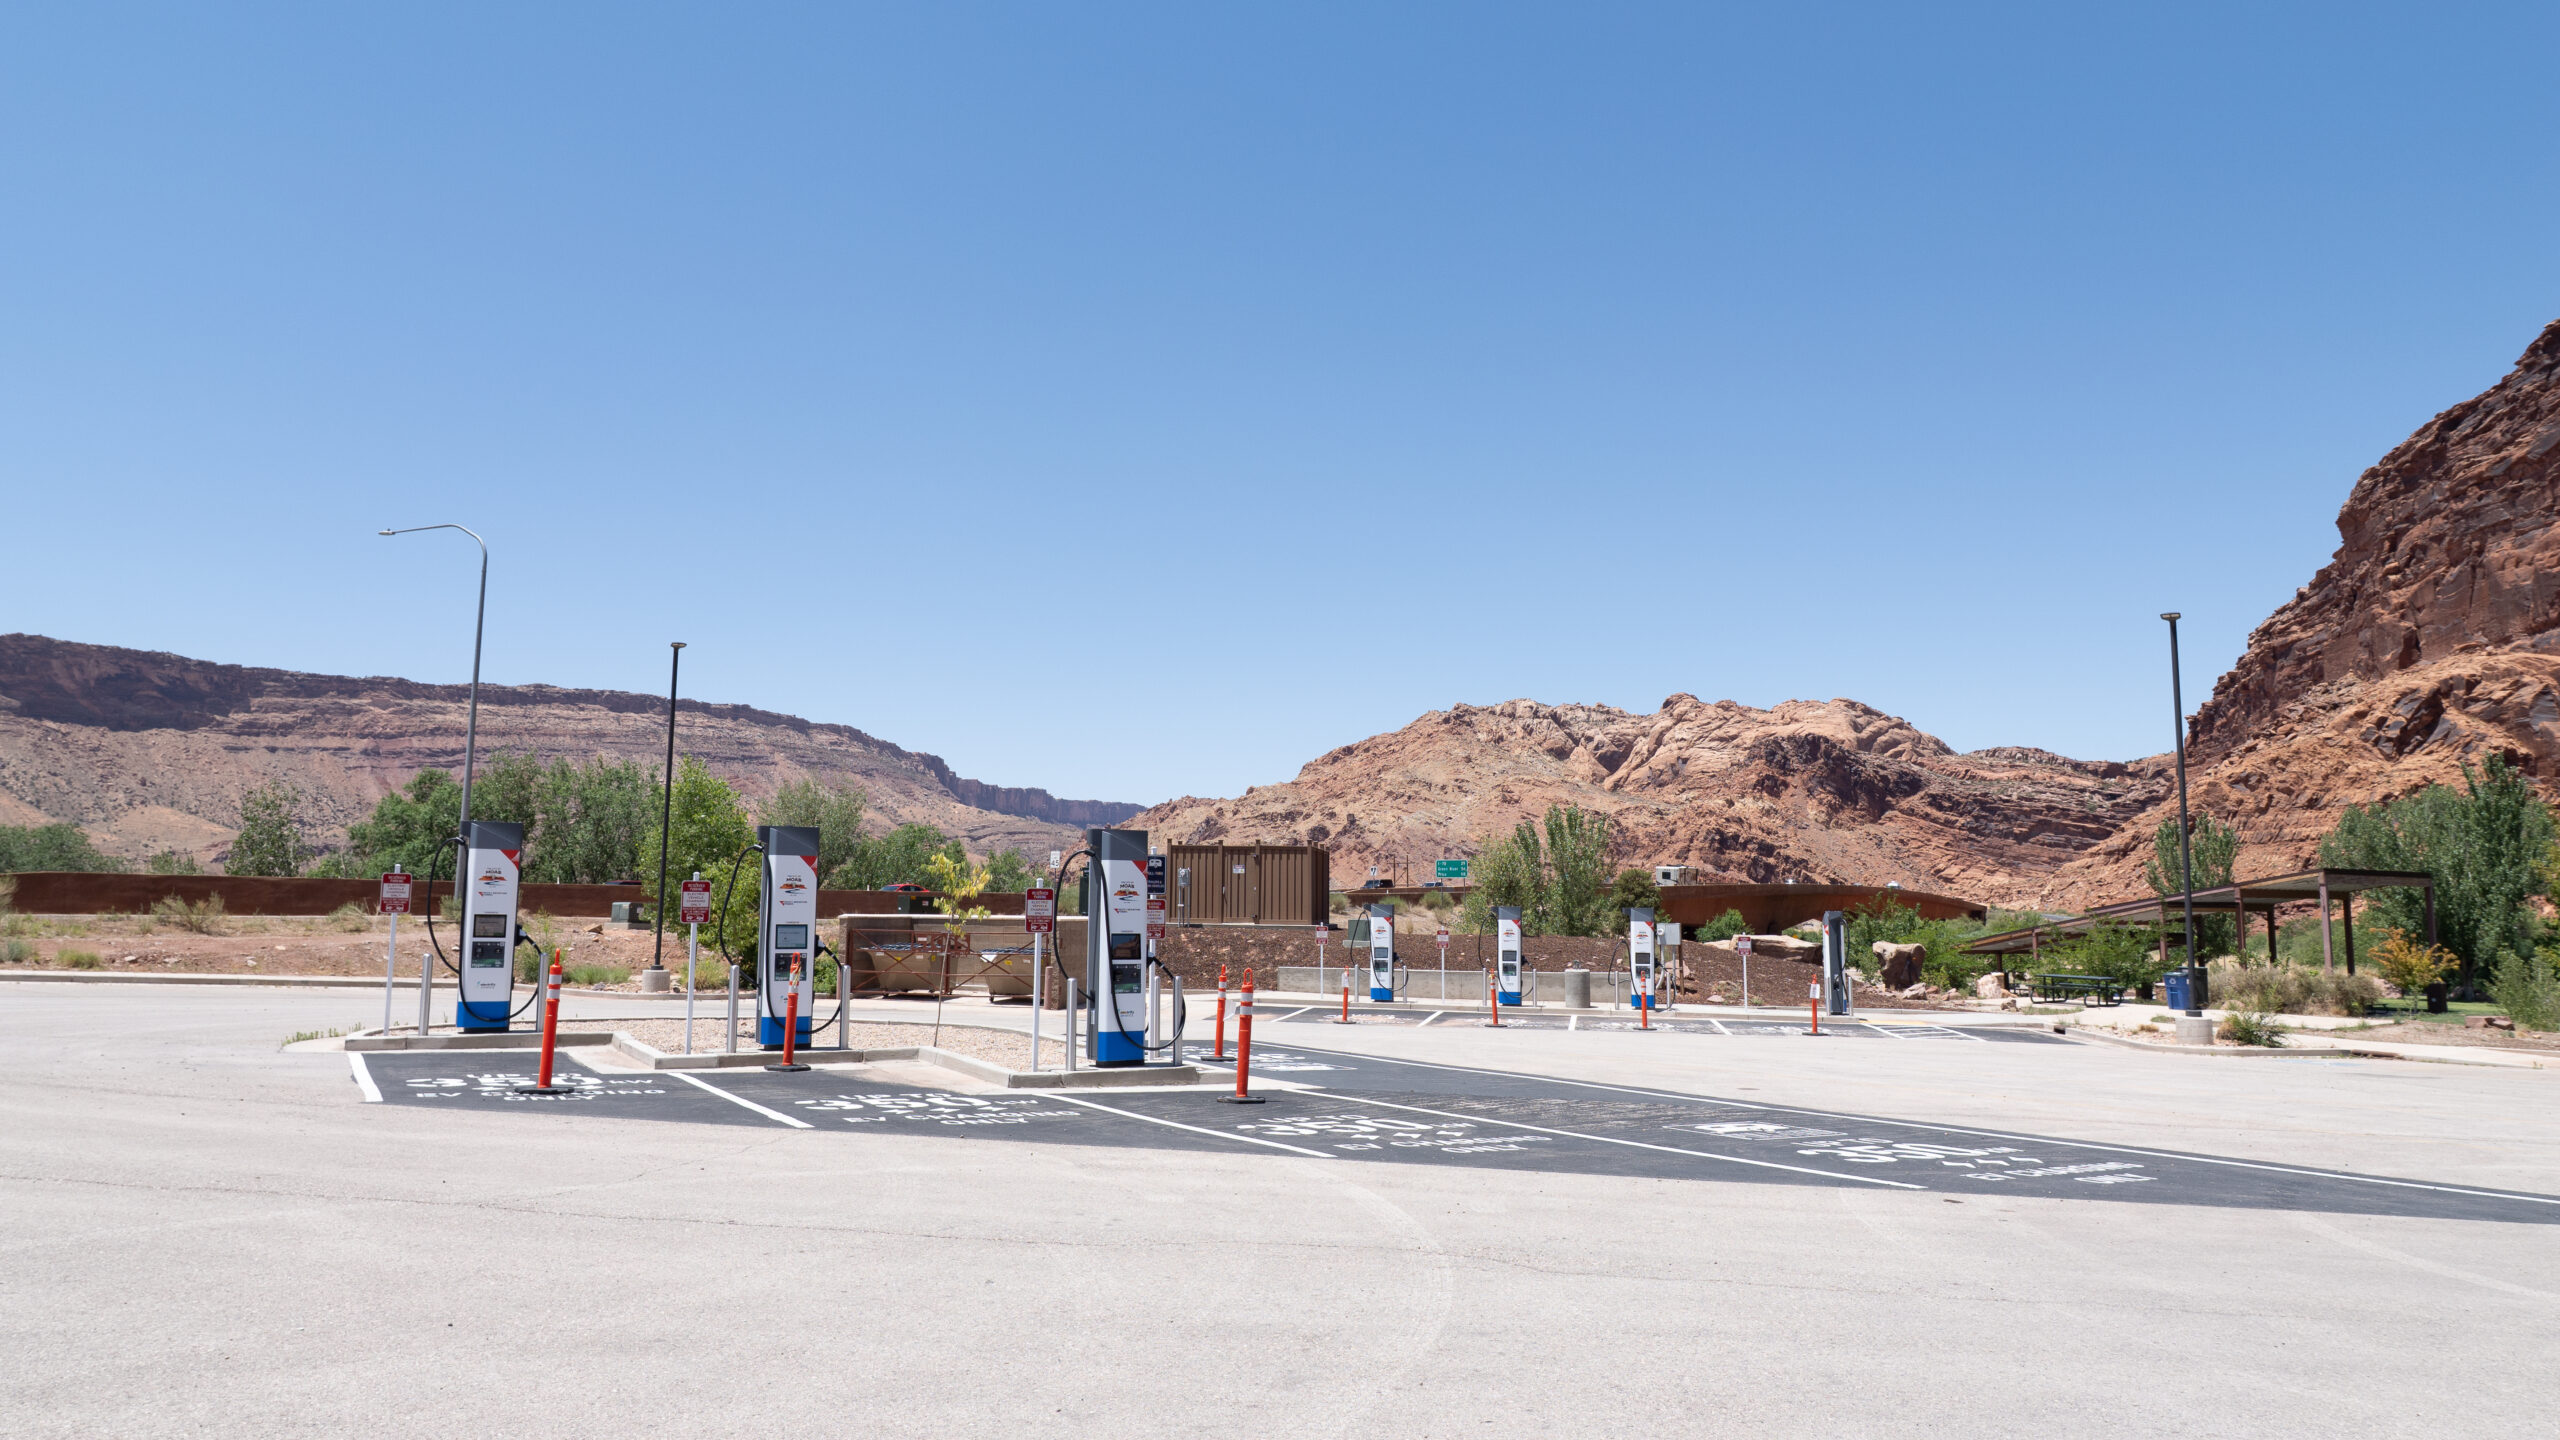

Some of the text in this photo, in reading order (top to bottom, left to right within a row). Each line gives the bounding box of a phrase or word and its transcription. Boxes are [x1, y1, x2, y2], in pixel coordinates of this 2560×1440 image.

[405, 1077, 604, 1087] 350
[794, 1097, 991, 1110] 350
[904, 1110, 1081, 1120] CHARGING
[940, 1117, 1029, 1125] ONLY
[1237, 1119, 1434, 1136] 350
[1332, 1135, 1553, 1151] EV CHARGING
[1441, 1143, 1529, 1154] ONLY
[1796, 1143, 1992, 1163] 350
